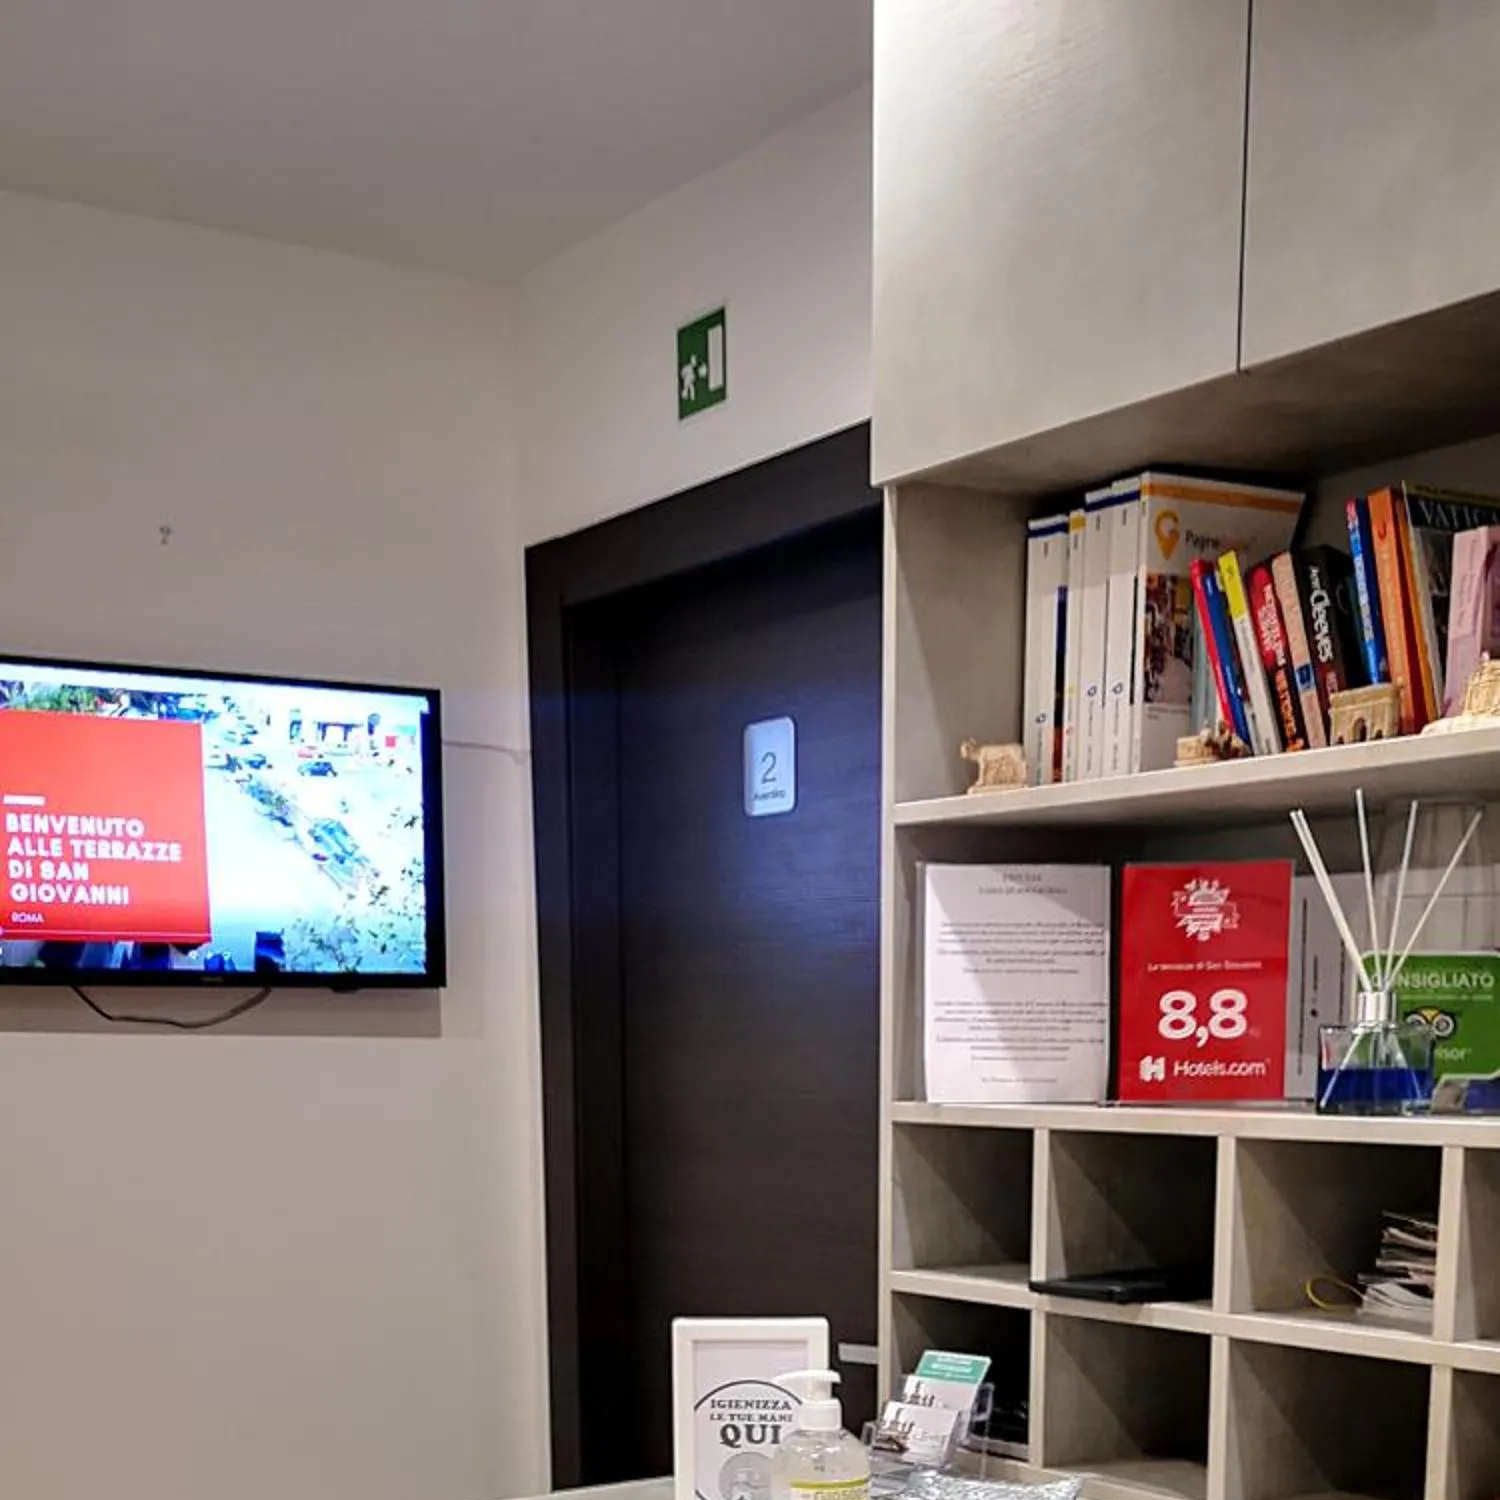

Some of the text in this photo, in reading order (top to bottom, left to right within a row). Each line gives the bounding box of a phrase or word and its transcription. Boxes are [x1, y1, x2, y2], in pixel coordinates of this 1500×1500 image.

[761, 751, 777, 784] 2
[5, 813, 145, 838] BENVENUTO
[7, 836, 182, 862] ALLE TERRAZZE
[8, 860, 89, 881] DI SAN
[10, 883, 129, 905] GIOVANNI
[11, 911, 44, 923] ROMA
[1158, 988, 1248, 1048] 8,8
[1173, 1059, 1267, 1077] Hotels.com
[710, 1398, 792, 1411] IGIENIZZA
[728, 1413, 756, 1422] TUE
[758, 1413, 793, 1423] MANI
[719, 1424, 783, 1449] QUI
